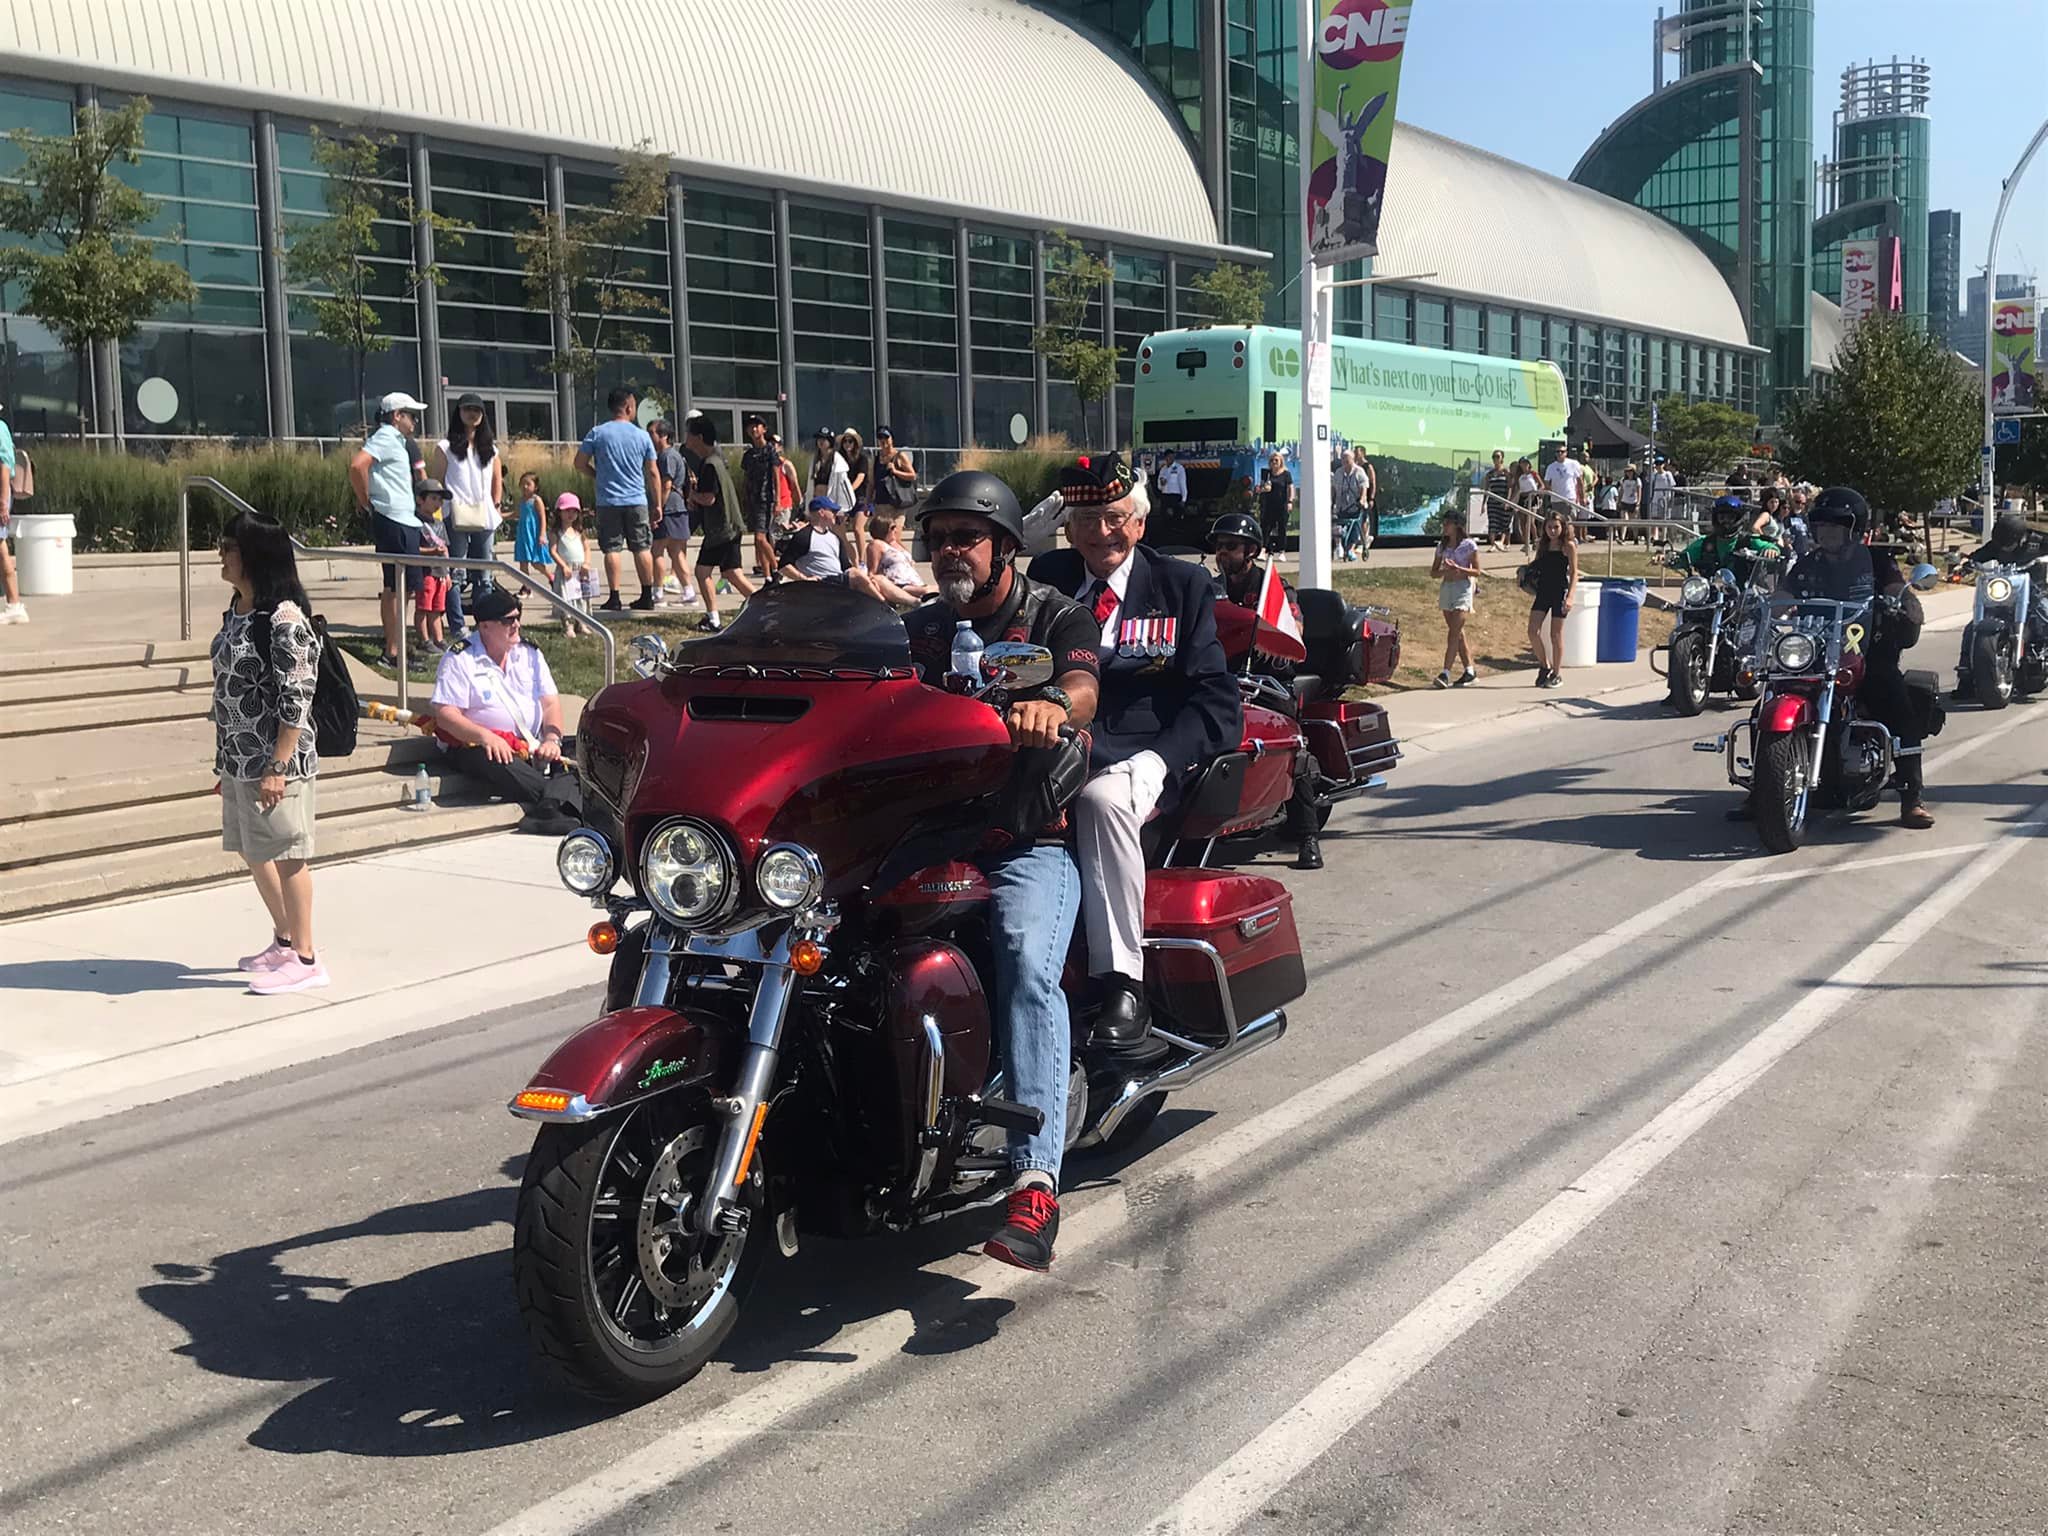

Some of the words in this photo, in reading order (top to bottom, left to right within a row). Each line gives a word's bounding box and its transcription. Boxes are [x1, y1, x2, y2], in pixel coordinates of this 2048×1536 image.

[1318, 6, 1410, 54] CNE
[1994, 312, 2035, 329] CNE
[1333, 356, 1380, 386] What's
[1383, 368, 1409, 389] next
[1412, 371, 1427, 391] on
[1430, 373, 1456, 396] your
[1459, 374, 1494, 397] to-GO
